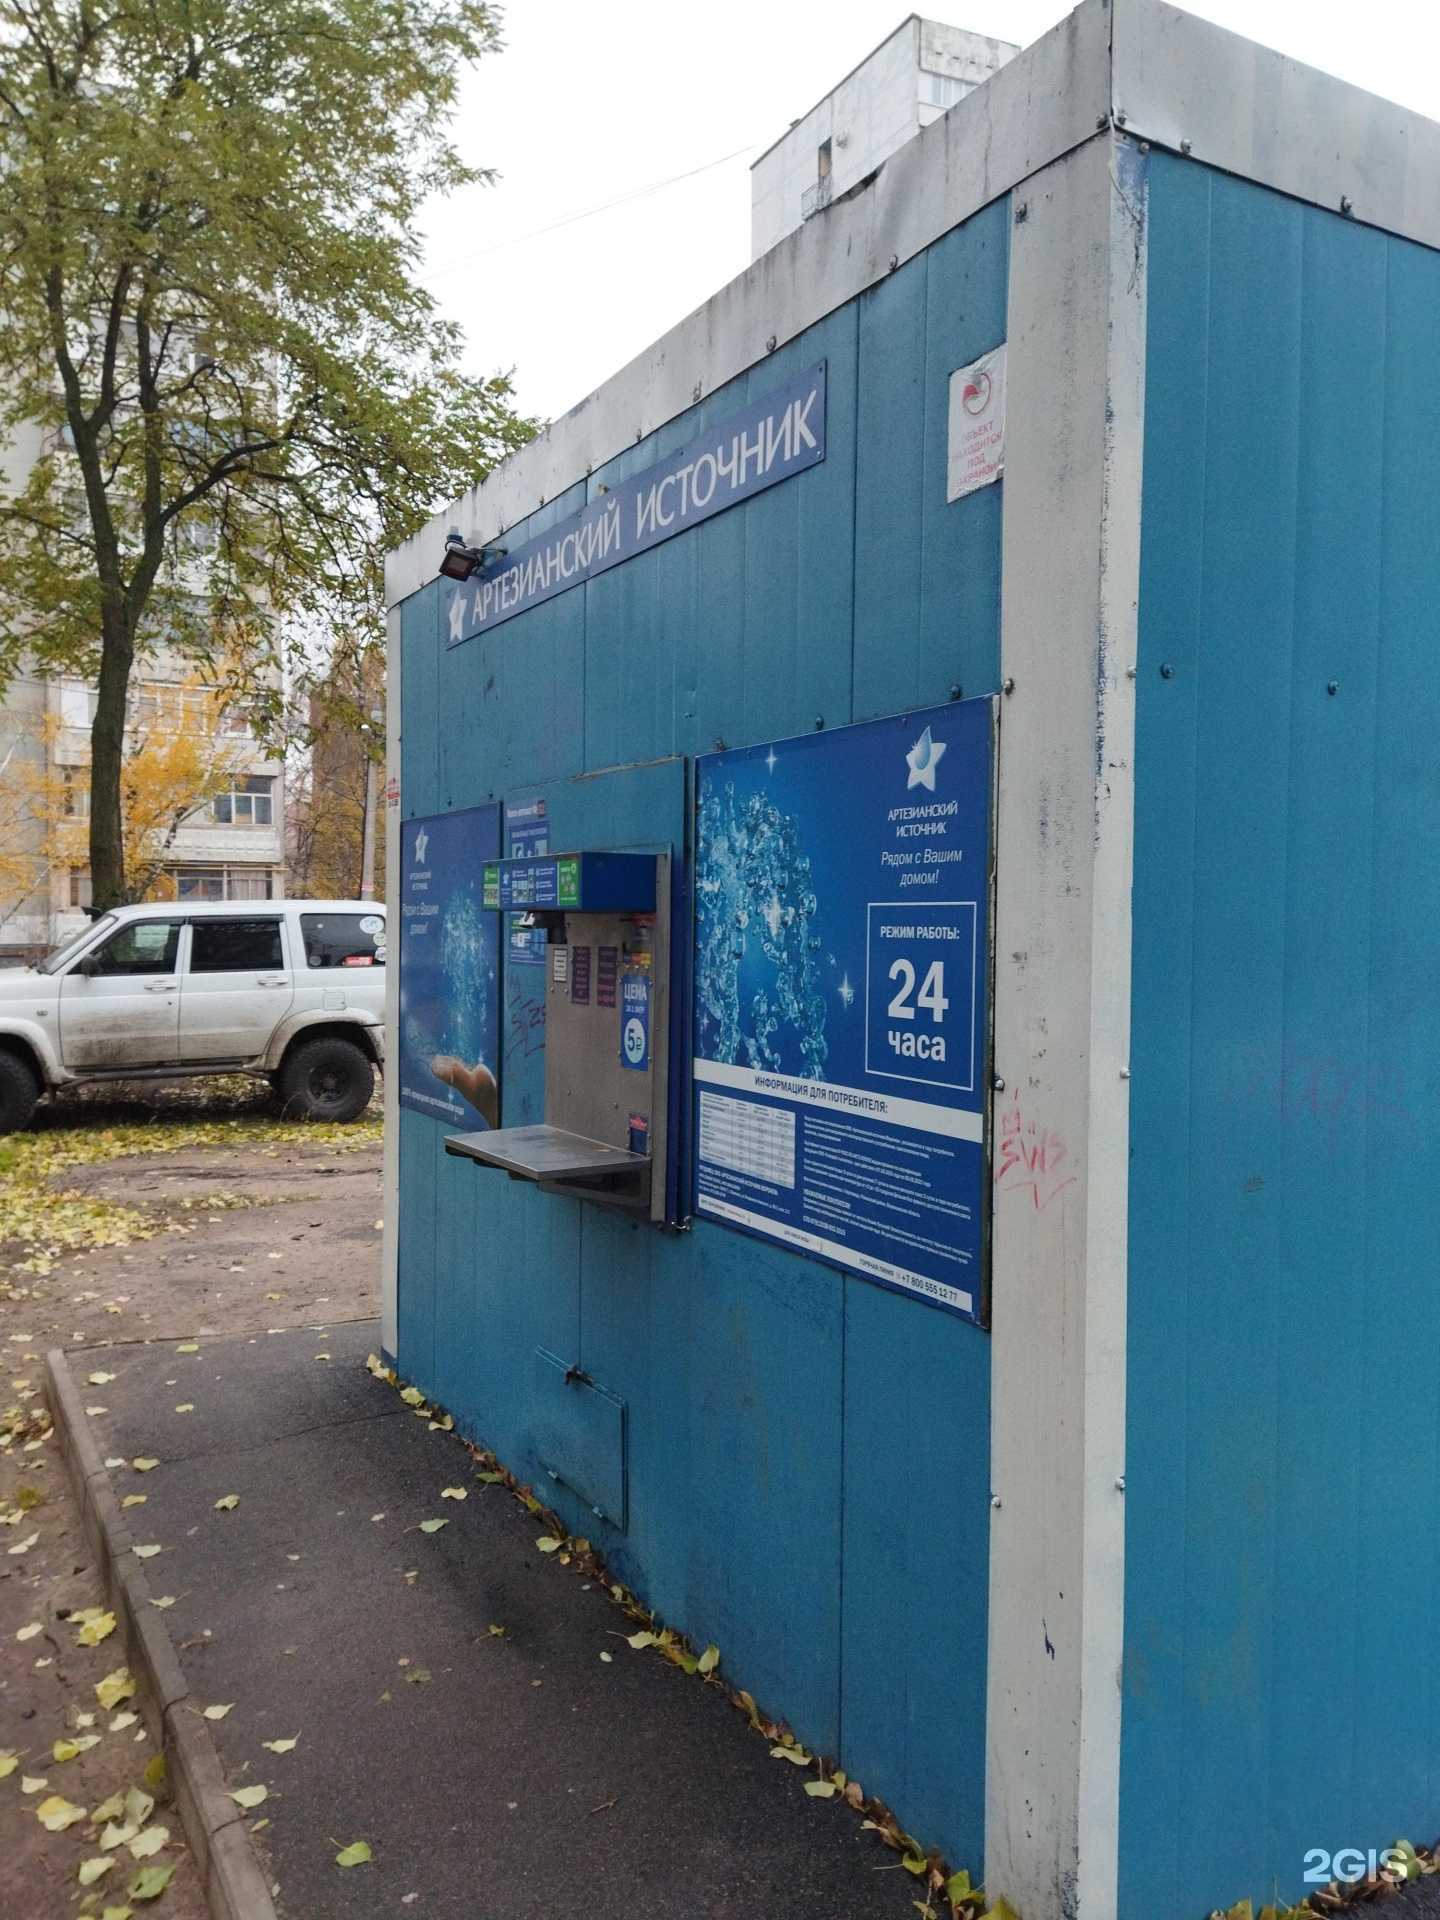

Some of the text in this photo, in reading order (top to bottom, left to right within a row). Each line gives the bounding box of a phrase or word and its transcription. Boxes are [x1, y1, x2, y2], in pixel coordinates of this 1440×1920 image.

[471, 389, 818, 626] АРТЕЗИАНСКИЙ ИСТОЧНИК
[888, 800, 959, 821] АРТЕЗИАНСКИЙ
[896, 822, 947, 837] ИСТОЧНИК
[881, 849, 962, 866] Рядом с Вашим
[899, 869, 940, 887] домом!
[880, 925, 961, 940] РЕЖИМ РАБОТЫ:
[624, 983, 648, 1001] ЦЕНА
[888, 958, 949, 1023] 24
[888, 1030, 946, 1062] часа
[754, 1076, 889, 1114] ИНФОРМАЦИЯ ДЛЯ ПОТРЕБИТЕЛЯ:
